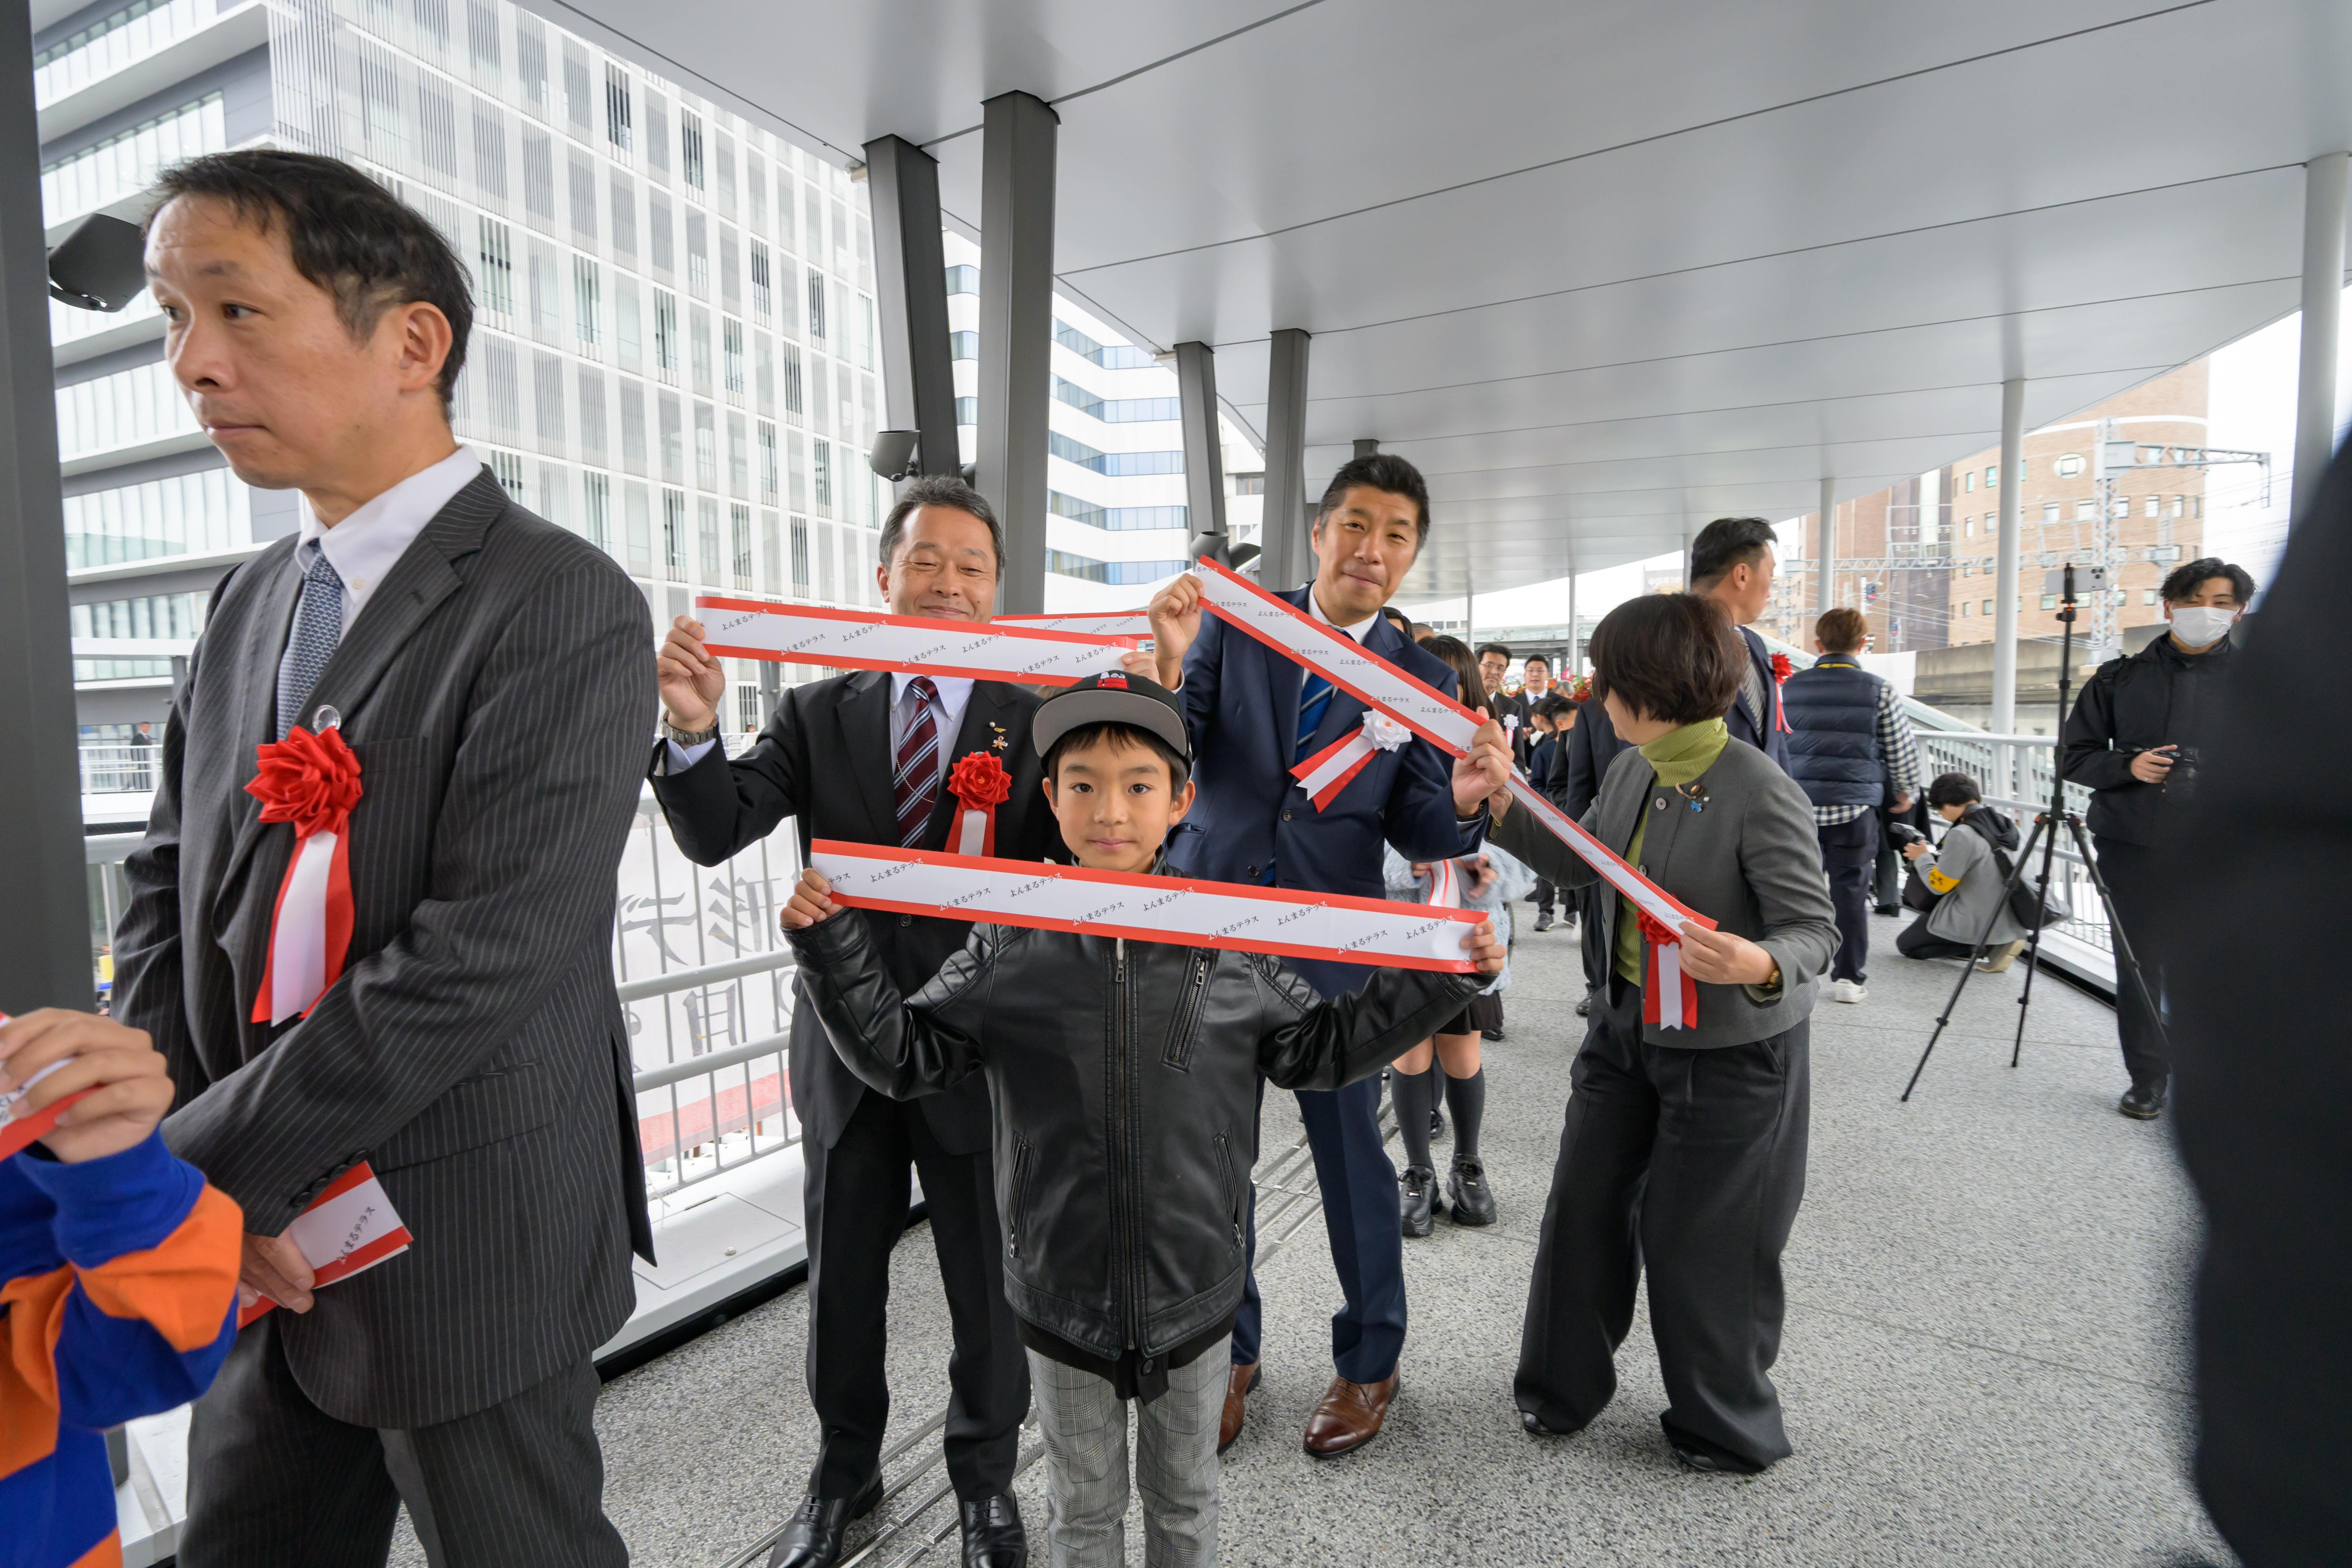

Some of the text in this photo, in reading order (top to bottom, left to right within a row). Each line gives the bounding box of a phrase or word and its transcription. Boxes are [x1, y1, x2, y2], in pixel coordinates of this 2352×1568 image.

[722, 609, 768, 631] よんまるテラス
[842, 620, 887, 642] よんまるテラス
[780, 633, 826, 656] よんまるテラス
[962, 631, 1006, 654] よんまるテラス
[1075, 642, 1118, 663] よんまるテラス
[901, 644, 946, 667] よんまるテラス
[1016, 655, 1060, 677] よんまるテラス
[870, 858, 924, 883] よんまるテラス
[1010, 872, 1063, 898] よんまるテラス
[938, 887, 991, 912] よんまるテラス
[1143, 886, 1195, 912] よんまるテラス
[1073, 901, 1124, 926] よんまるテラス
[1277, 901, 1328, 926] よんまるテラス
[1208, 916, 1259, 941] よんまるテラス
[1406, 915, 1455, 940] よんまるテラス
[1337, 929, 1388, 955] よんまるテラス
[336, 1207, 375, 1265] よんまるテラス
